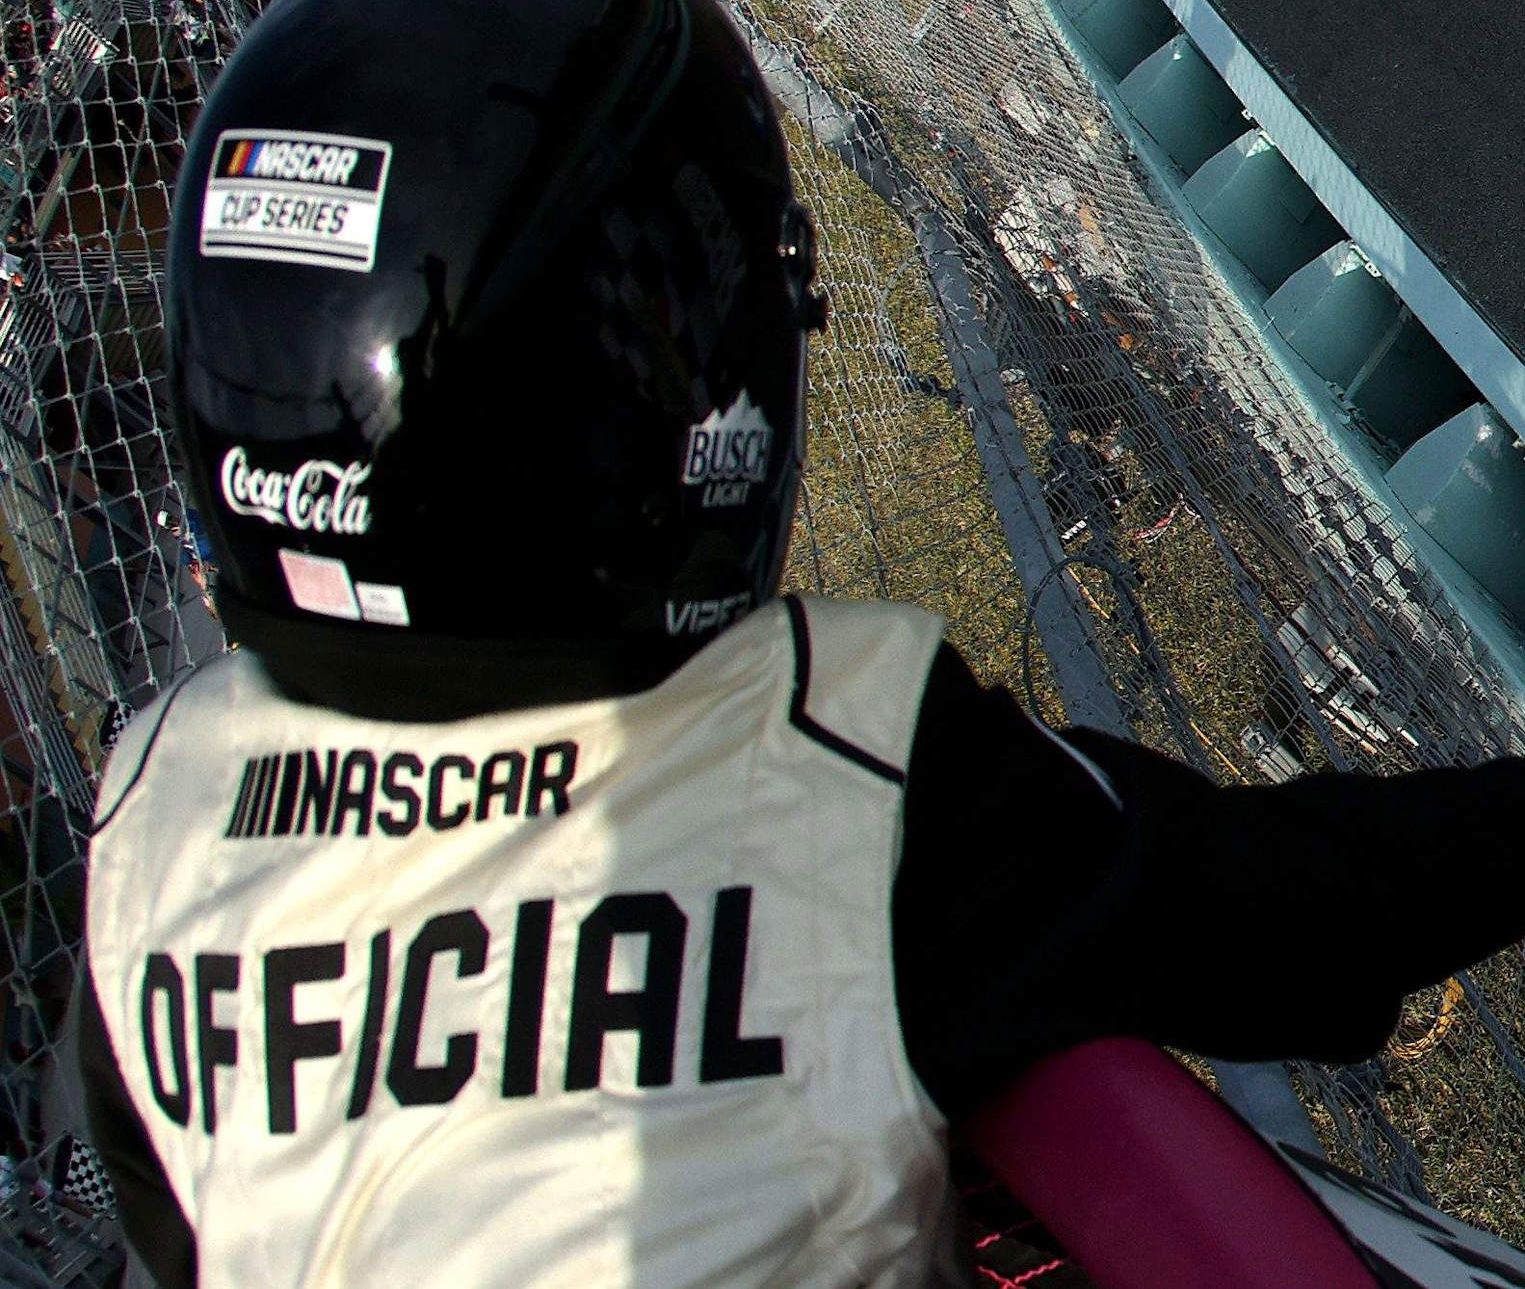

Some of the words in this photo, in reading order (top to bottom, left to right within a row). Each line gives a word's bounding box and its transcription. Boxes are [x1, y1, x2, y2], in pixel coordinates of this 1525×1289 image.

[253, 140, 359, 185] NASCAR
[221, 195, 261, 224] CUP
[262, 197, 348, 234] SERIES
[689, 428, 768, 479] BUSCH
[221, 446, 374, 535] Coca-Cola
[297, 740, 579, 838] NASCAR
[141, 885, 784, 1135] OFFICIAL
